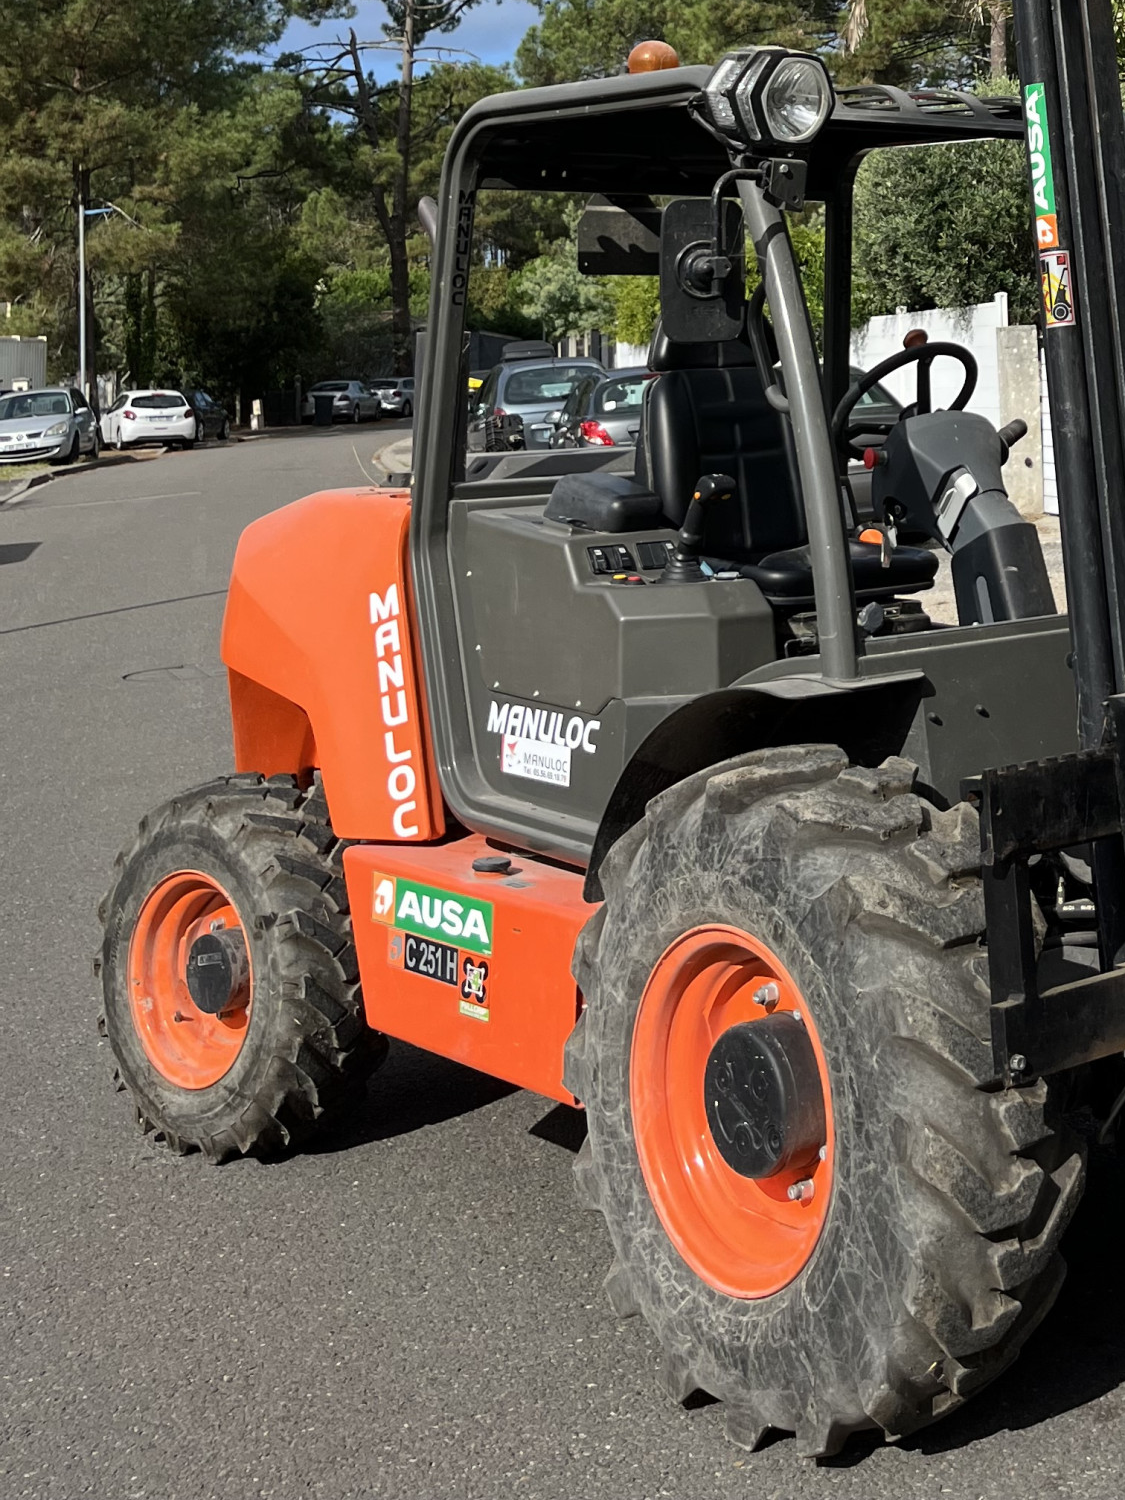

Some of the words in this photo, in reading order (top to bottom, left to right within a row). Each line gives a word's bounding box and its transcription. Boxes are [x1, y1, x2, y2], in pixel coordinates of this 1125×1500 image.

[1026, 90, 1049, 211] AUSA
[452, 190, 476, 306] MANULOC
[368, 583, 418, 838] MANULOC
[487, 700, 601, 754] MANULOC
[523, 752, 568, 774] MANULOC
[397, 890, 490, 944] AUSA
[405, 937, 417, 968] C
[418, 942, 442, 977] 251
[446, 949, 458, 982] H
